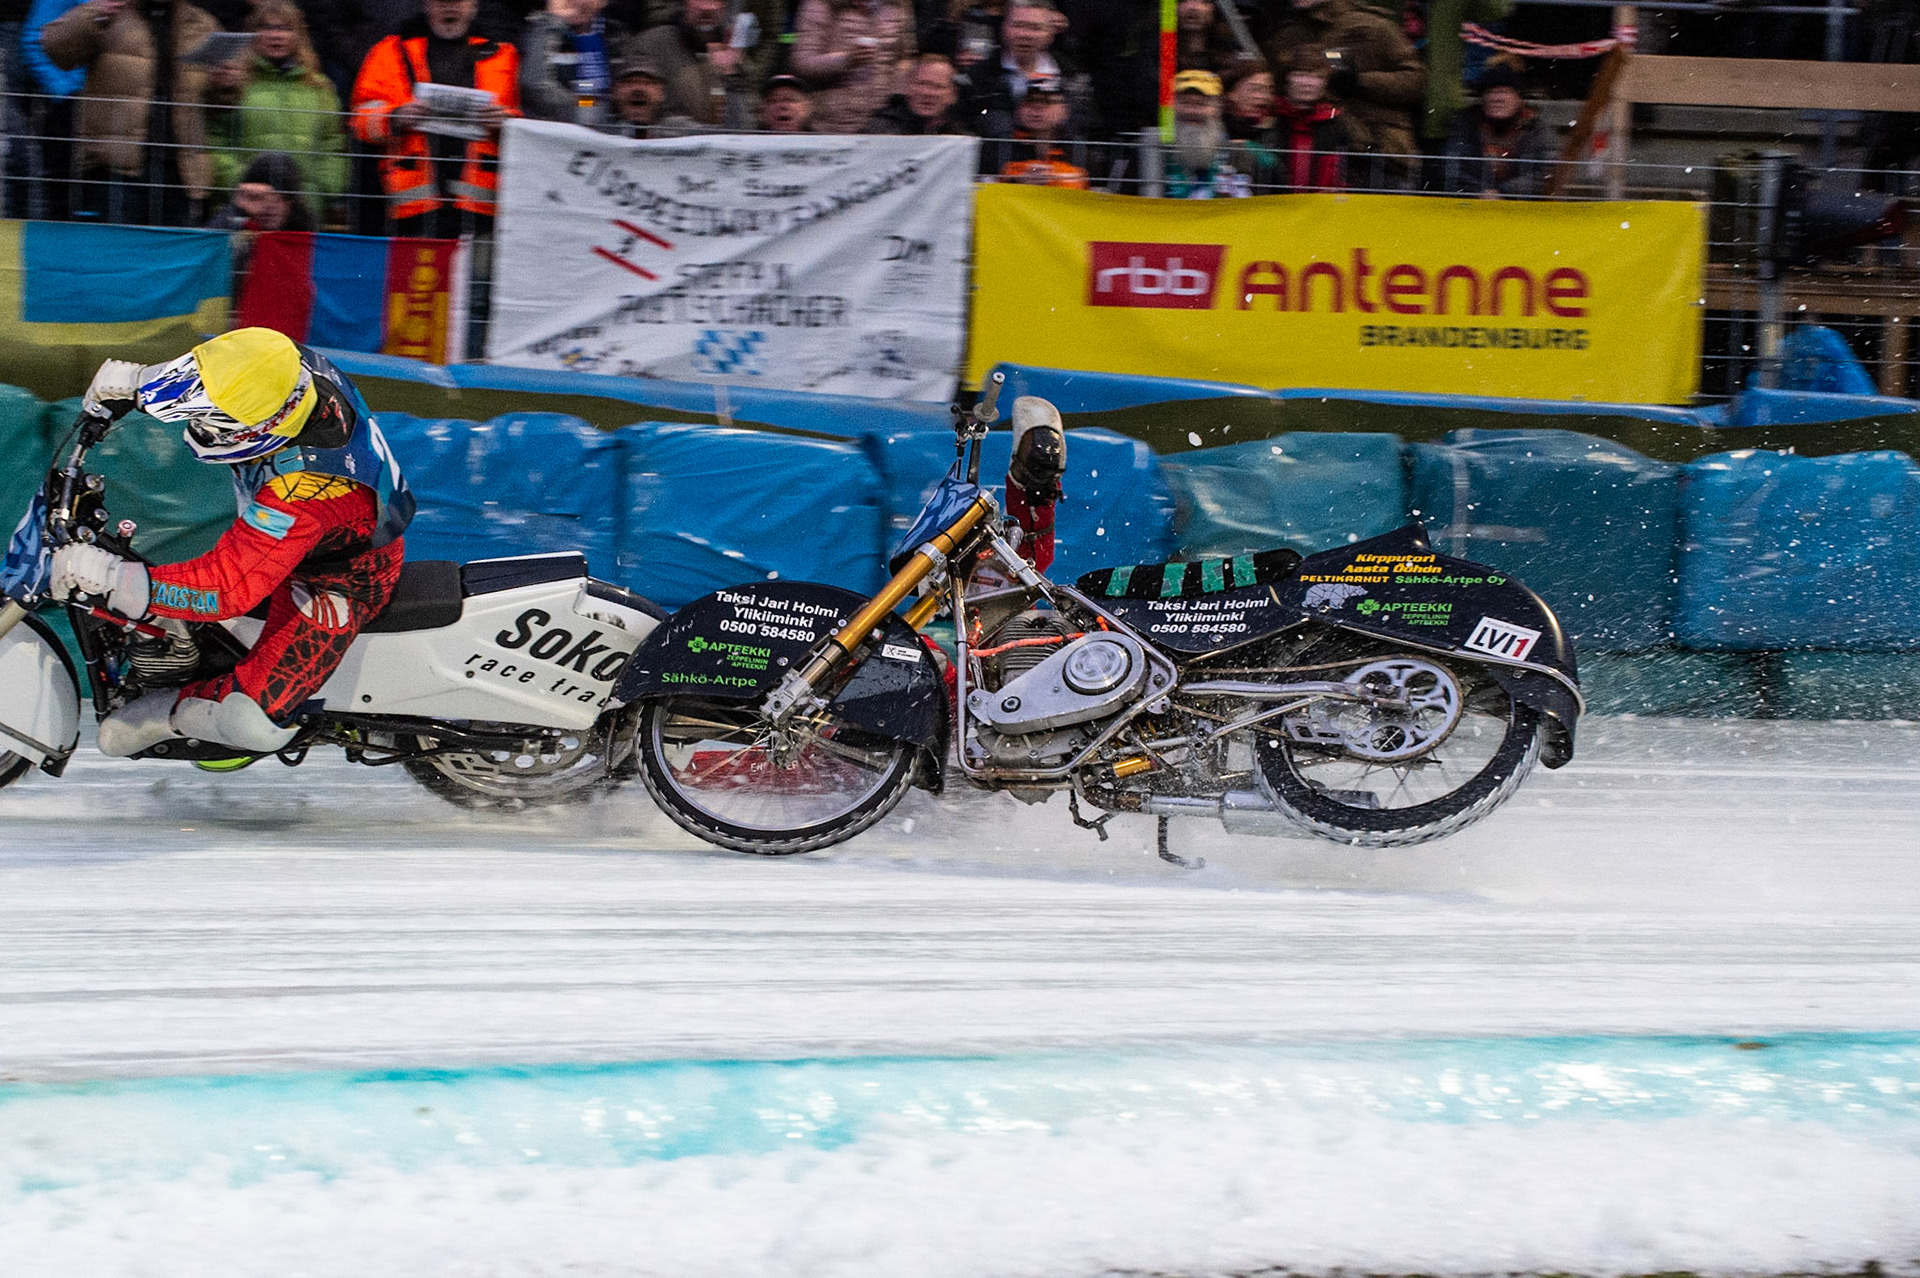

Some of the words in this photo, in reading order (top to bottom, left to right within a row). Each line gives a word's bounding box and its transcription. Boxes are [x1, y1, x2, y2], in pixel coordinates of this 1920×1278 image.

[1095, 256, 1210, 297] rbb
[1238, 248, 1590, 318] Antenne
[1360, 325, 1590, 351] BRANDENBURG
[1355, 554, 1436, 564] Kirpputori
[1342, 565, 1389, 573] Aasta
[1300, 575, 1390, 583] PELTIKARHUT
[1395, 575, 1483, 585] Sähkö-Artpe
[1487, 576, 1507, 585] Oy
[716, 591, 756, 606] Taksi
[759, 597, 790, 611] Jari
[793, 602, 839, 619] Holmi
[1147, 601, 1187, 611] Taksi
[1189, 600, 1221, 611] Jari
[1223, 597, 1270, 610] Holmi
[1381, 603, 1452, 612] APTEEKKI
[734, 607, 814, 629] Ylikiiminki
[1165, 611, 1245, 622] Ylikiiminki
[720, 620, 757, 635] 0500
[760, 626, 815, 643] 584580
[1150, 624, 1188, 633] 0500
[1191, 623, 1247, 633] 584580
[708, 642, 771, 658] APTEEKKI
[1473, 626, 1530, 658] LVI1
[465, 653, 536, 683] race
[661, 672, 757, 688] Sähkö-Artpe
